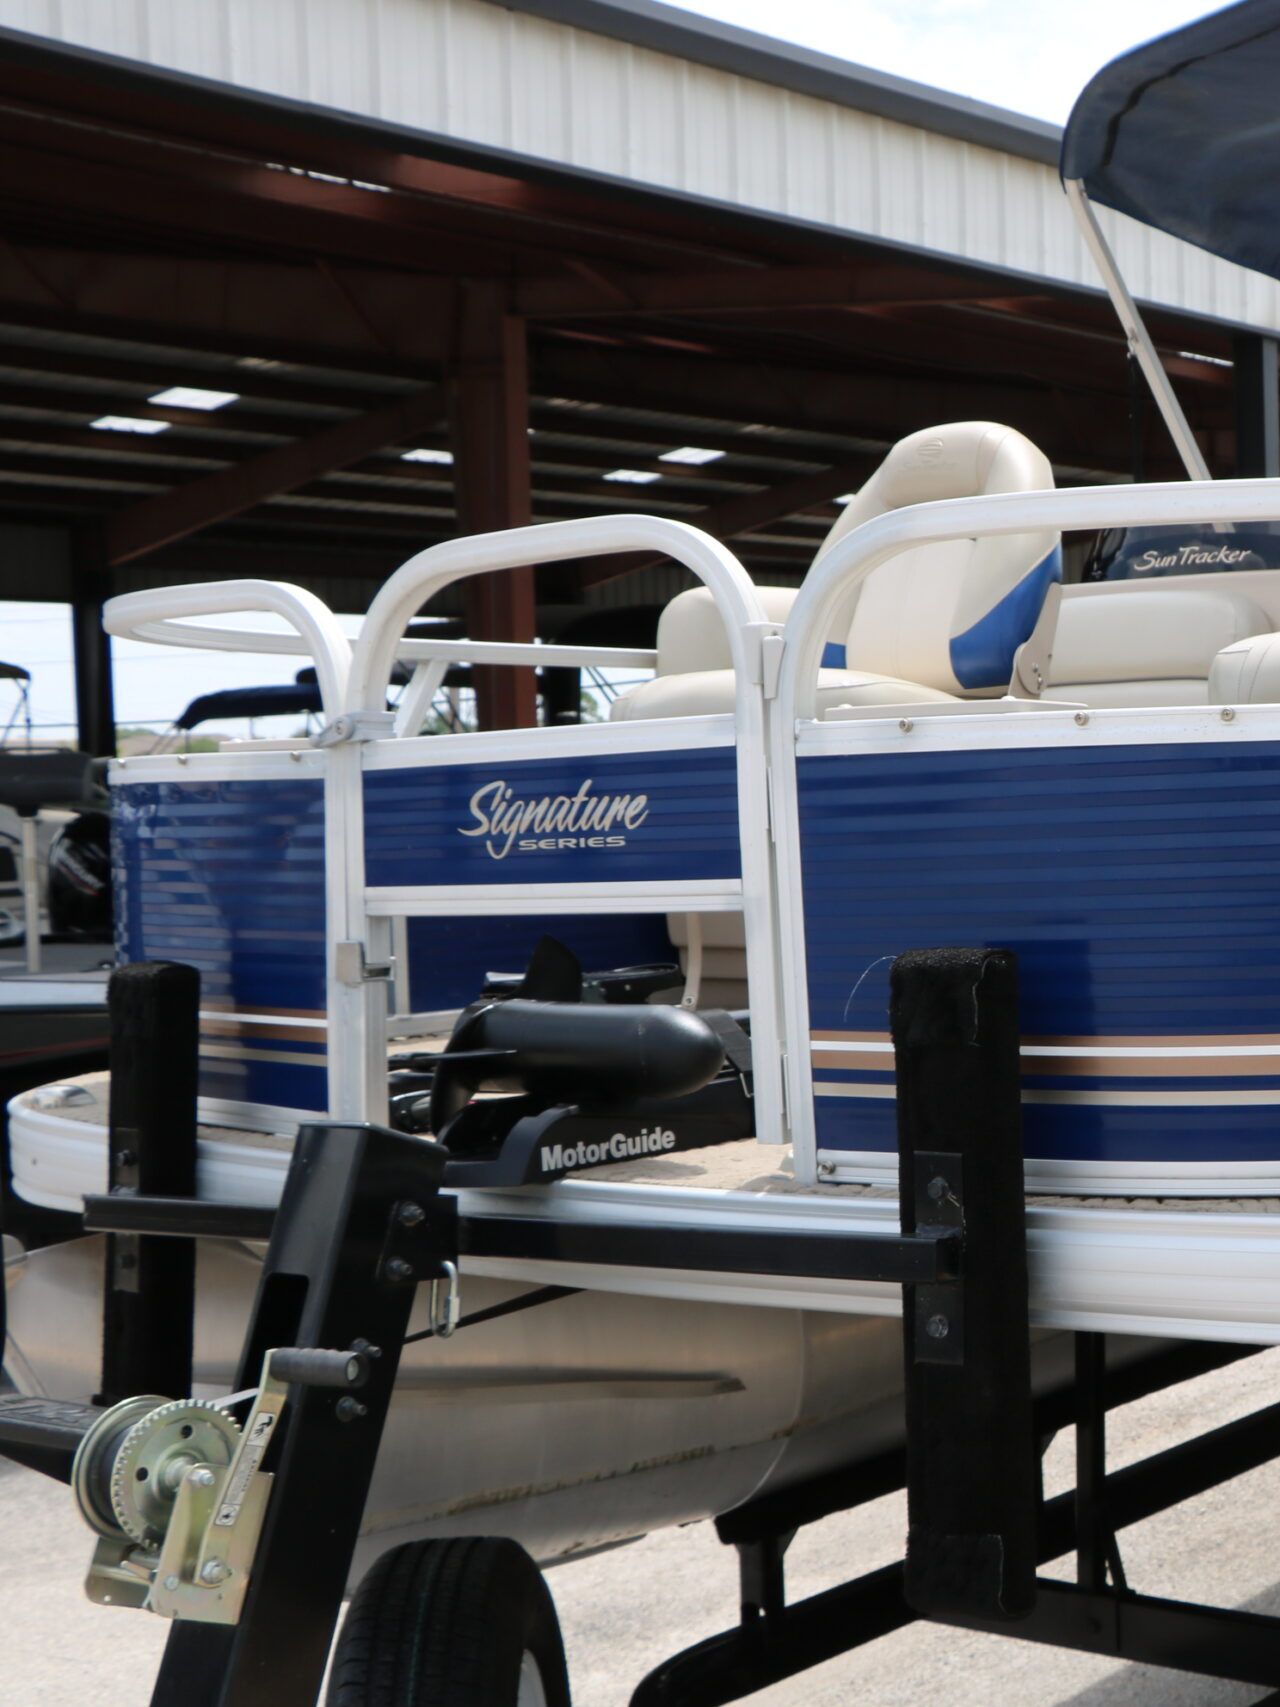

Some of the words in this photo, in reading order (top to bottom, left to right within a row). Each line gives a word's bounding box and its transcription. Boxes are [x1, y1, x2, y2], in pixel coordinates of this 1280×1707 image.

[456, 778, 649, 860] Signature
[518, 835, 626, 851] SERIES
[540, 1126, 676, 1172] MotorGuide
